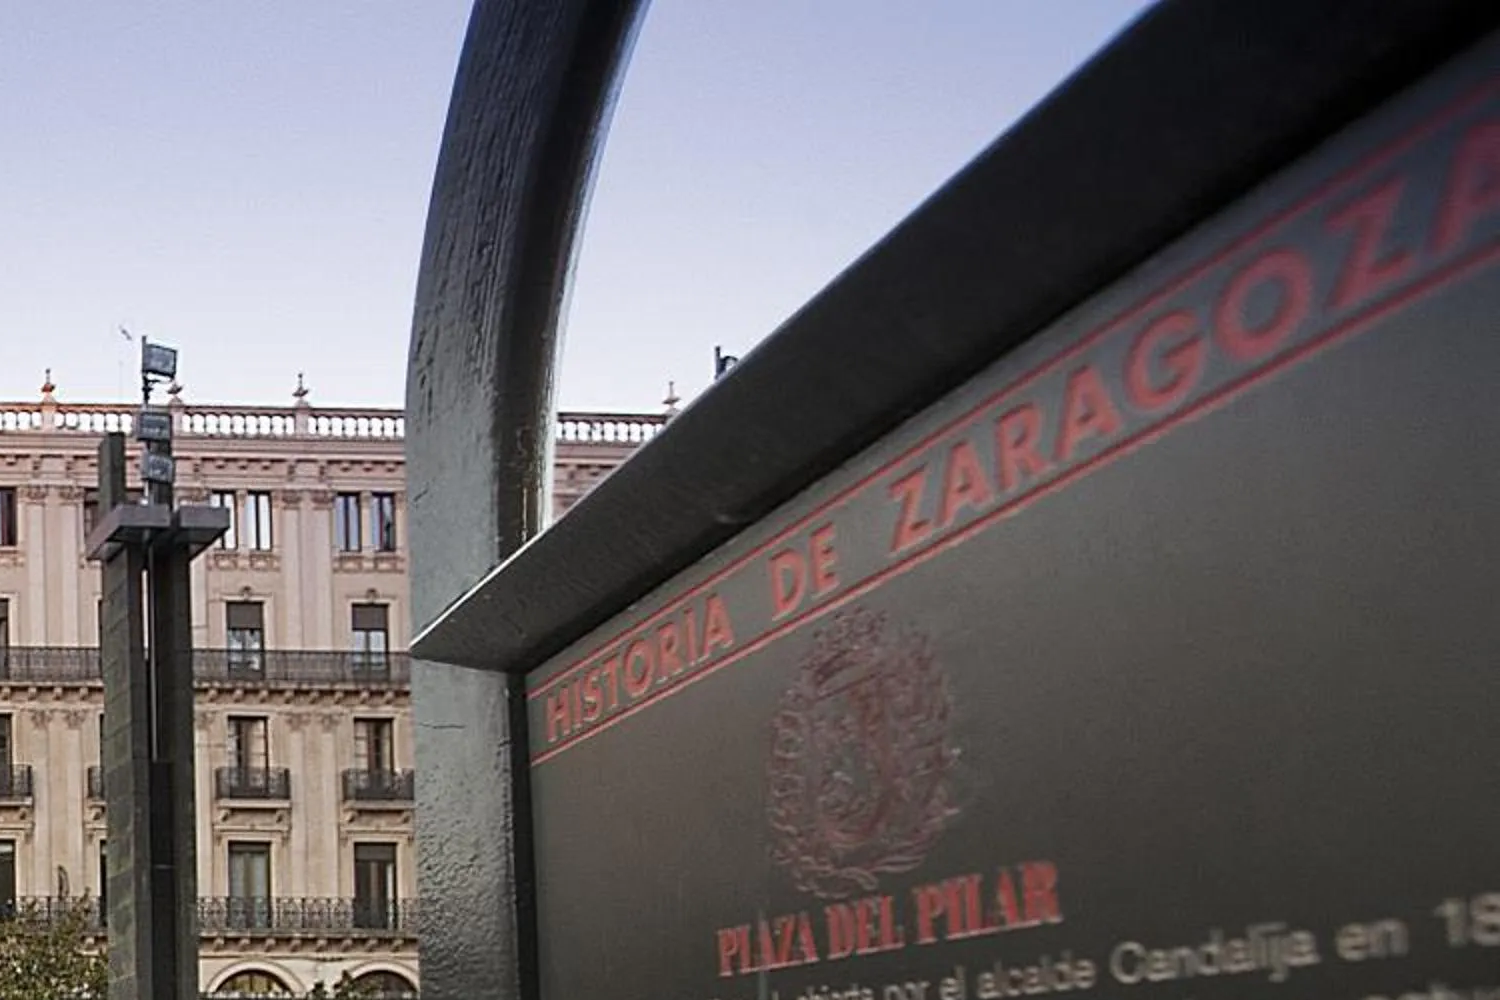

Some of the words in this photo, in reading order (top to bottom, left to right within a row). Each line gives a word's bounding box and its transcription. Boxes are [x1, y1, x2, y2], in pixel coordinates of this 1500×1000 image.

[546, 593, 734, 744] HISTORIA
[768, 521, 840, 621] DE
[717, 911, 820, 978] PLAZA
[825, 895, 906, 960] DEL
[913, 860, 1063, 945] PILAR
[978, 954, 1095, 999] alcalde
[1111, 923, 1320, 983] Candalija
[1336, 919, 1408, 960] en
